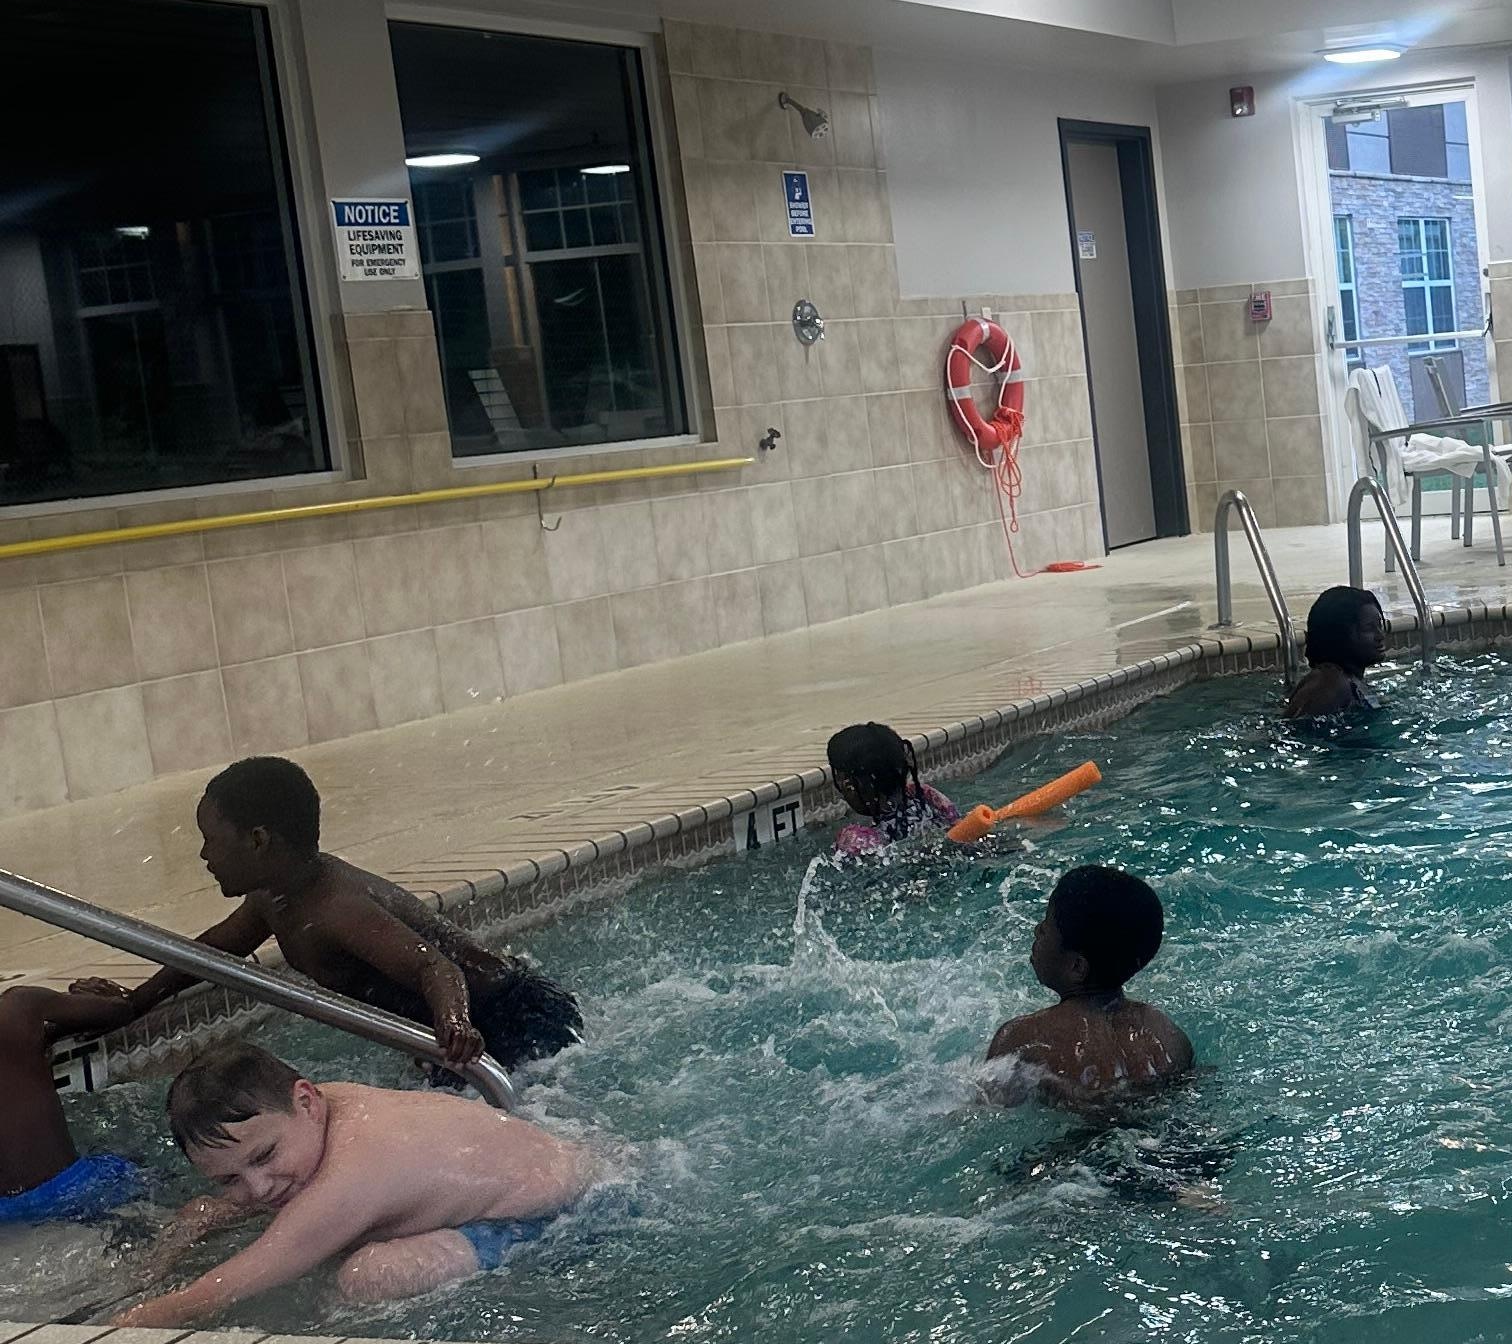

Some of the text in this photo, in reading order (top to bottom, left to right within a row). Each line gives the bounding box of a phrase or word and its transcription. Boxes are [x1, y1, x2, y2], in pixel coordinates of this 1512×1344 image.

[344, 205, 400, 224] NOTICE
[347, 230, 403, 241] LIFESAVING
[349, 244, 405, 256] EQUIPMENT
[772, 801, 800, 843] FT
